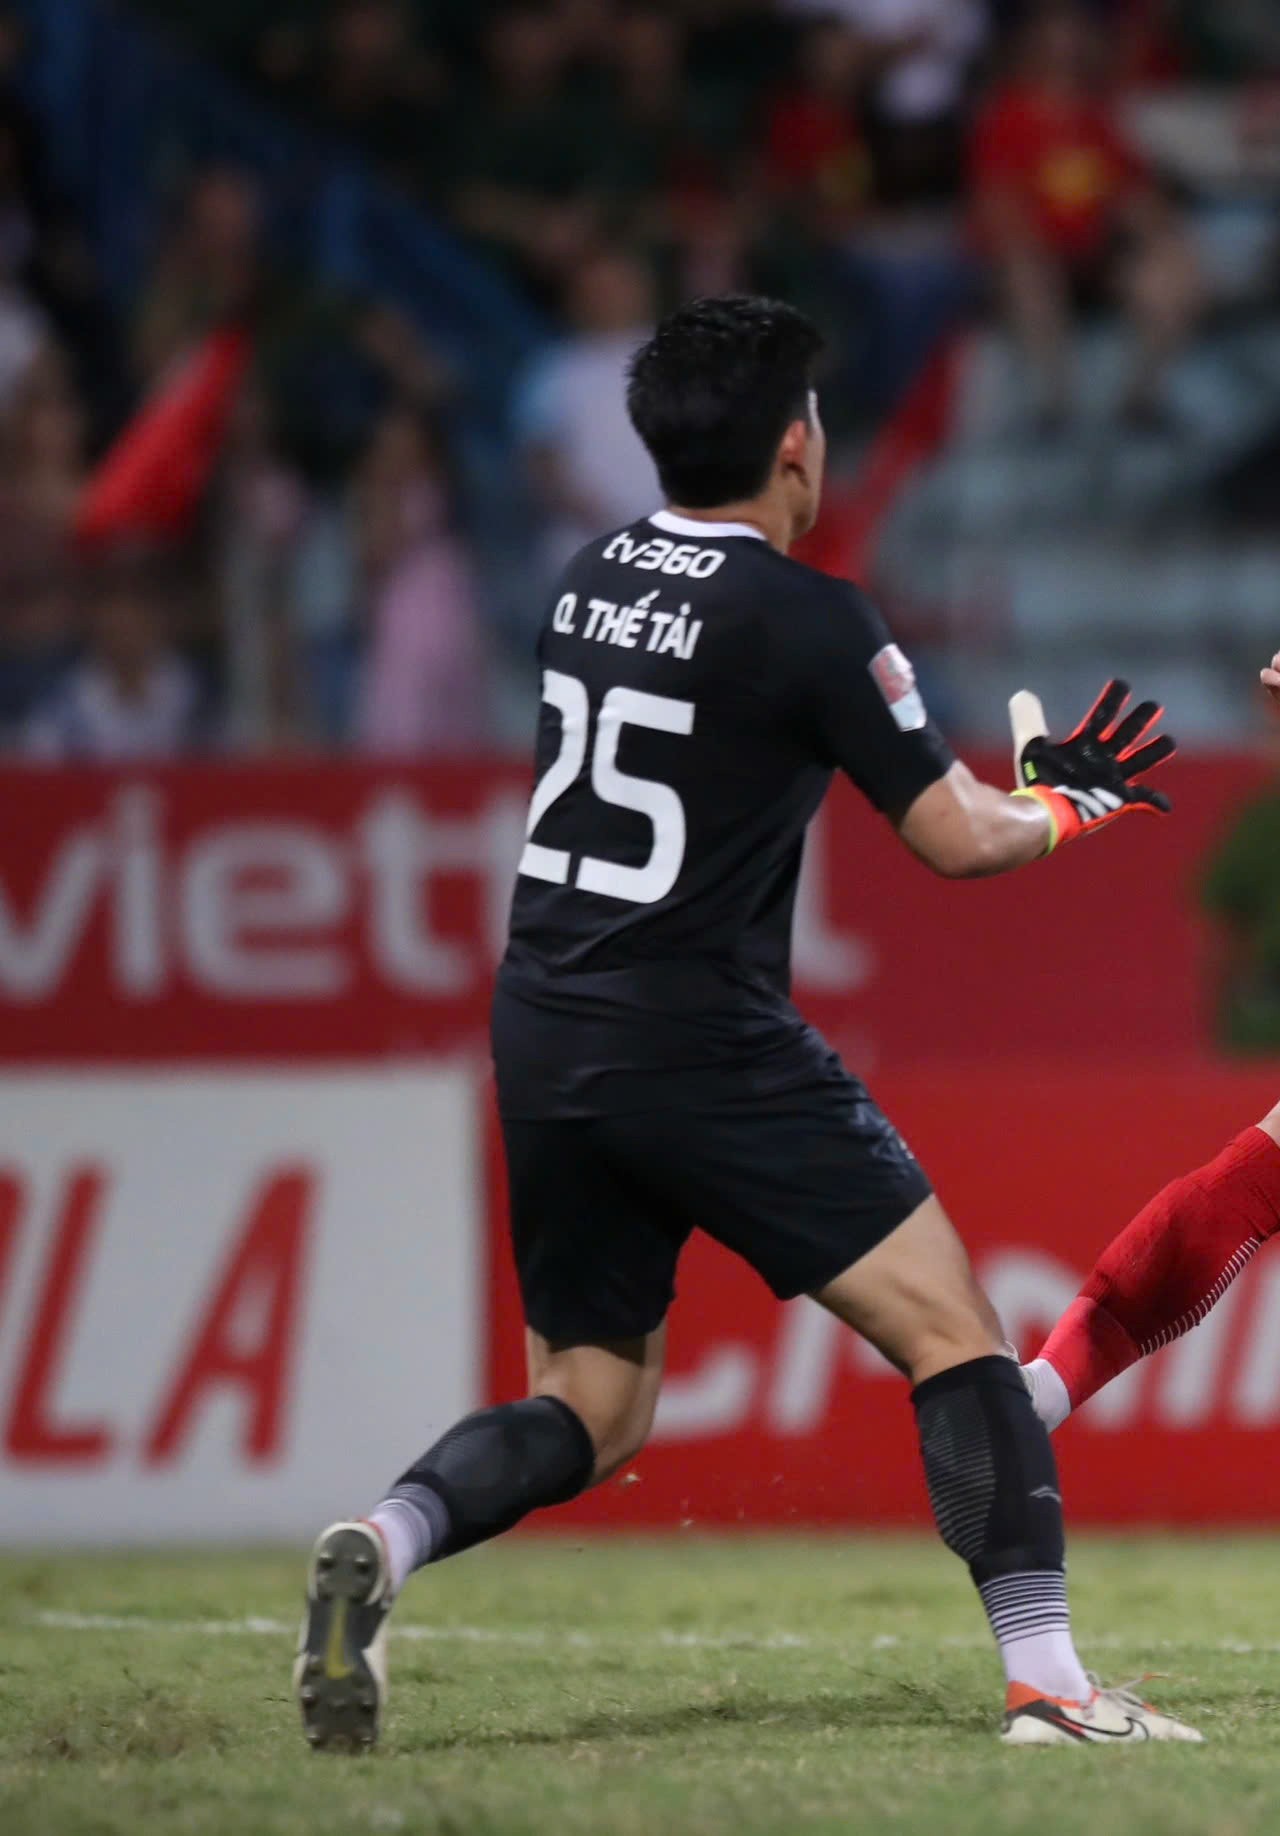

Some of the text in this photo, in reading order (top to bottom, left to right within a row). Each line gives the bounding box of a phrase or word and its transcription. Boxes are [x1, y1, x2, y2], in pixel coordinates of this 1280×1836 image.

[582, 588, 661, 648] THẾ
[602, 531, 727, 579] tv360
[518, 669, 695, 904] 25
[0, 1152, 322, 1472] LA
